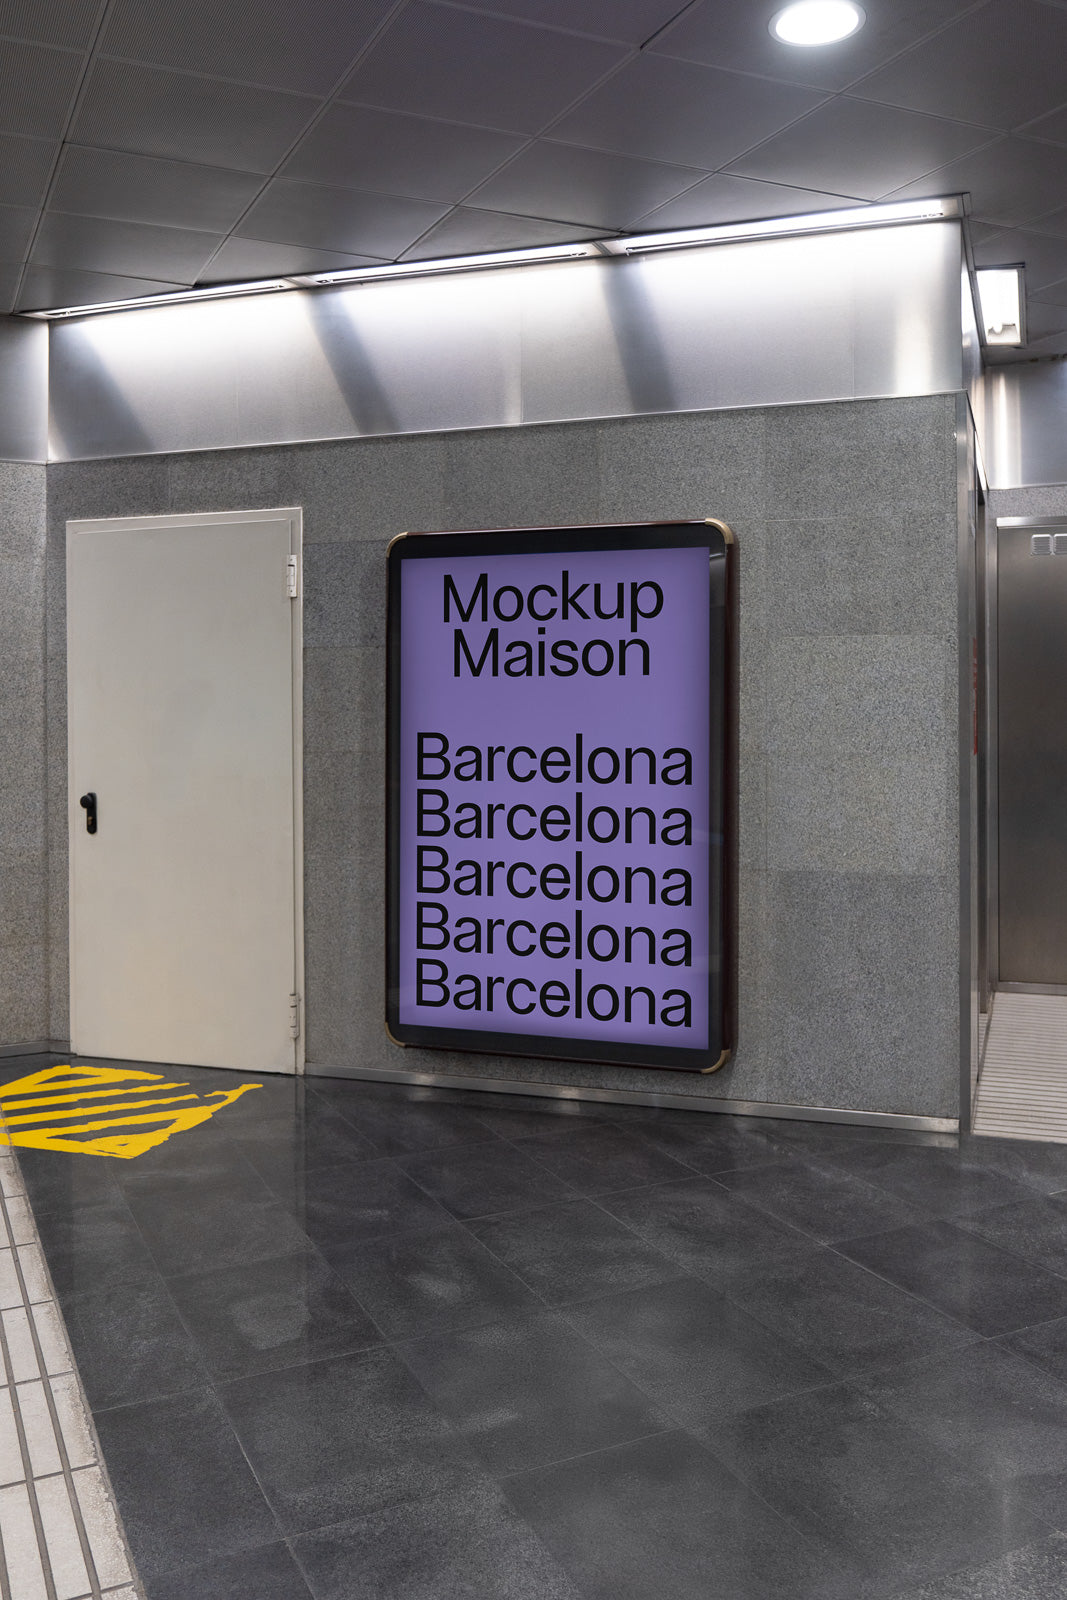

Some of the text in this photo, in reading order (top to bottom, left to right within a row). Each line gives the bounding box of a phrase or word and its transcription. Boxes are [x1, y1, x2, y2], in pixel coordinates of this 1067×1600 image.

[443, 569, 664, 633] Mockup
[453, 627, 650, 678] Maison
[416, 731, 693, 786] Barcelona
[416, 788, 693, 846] Barcelona
[416, 844, 693, 907] Barcelona
[415, 901, 692, 967] Barcelona
[415, 957, 692, 1028] Barcelona
